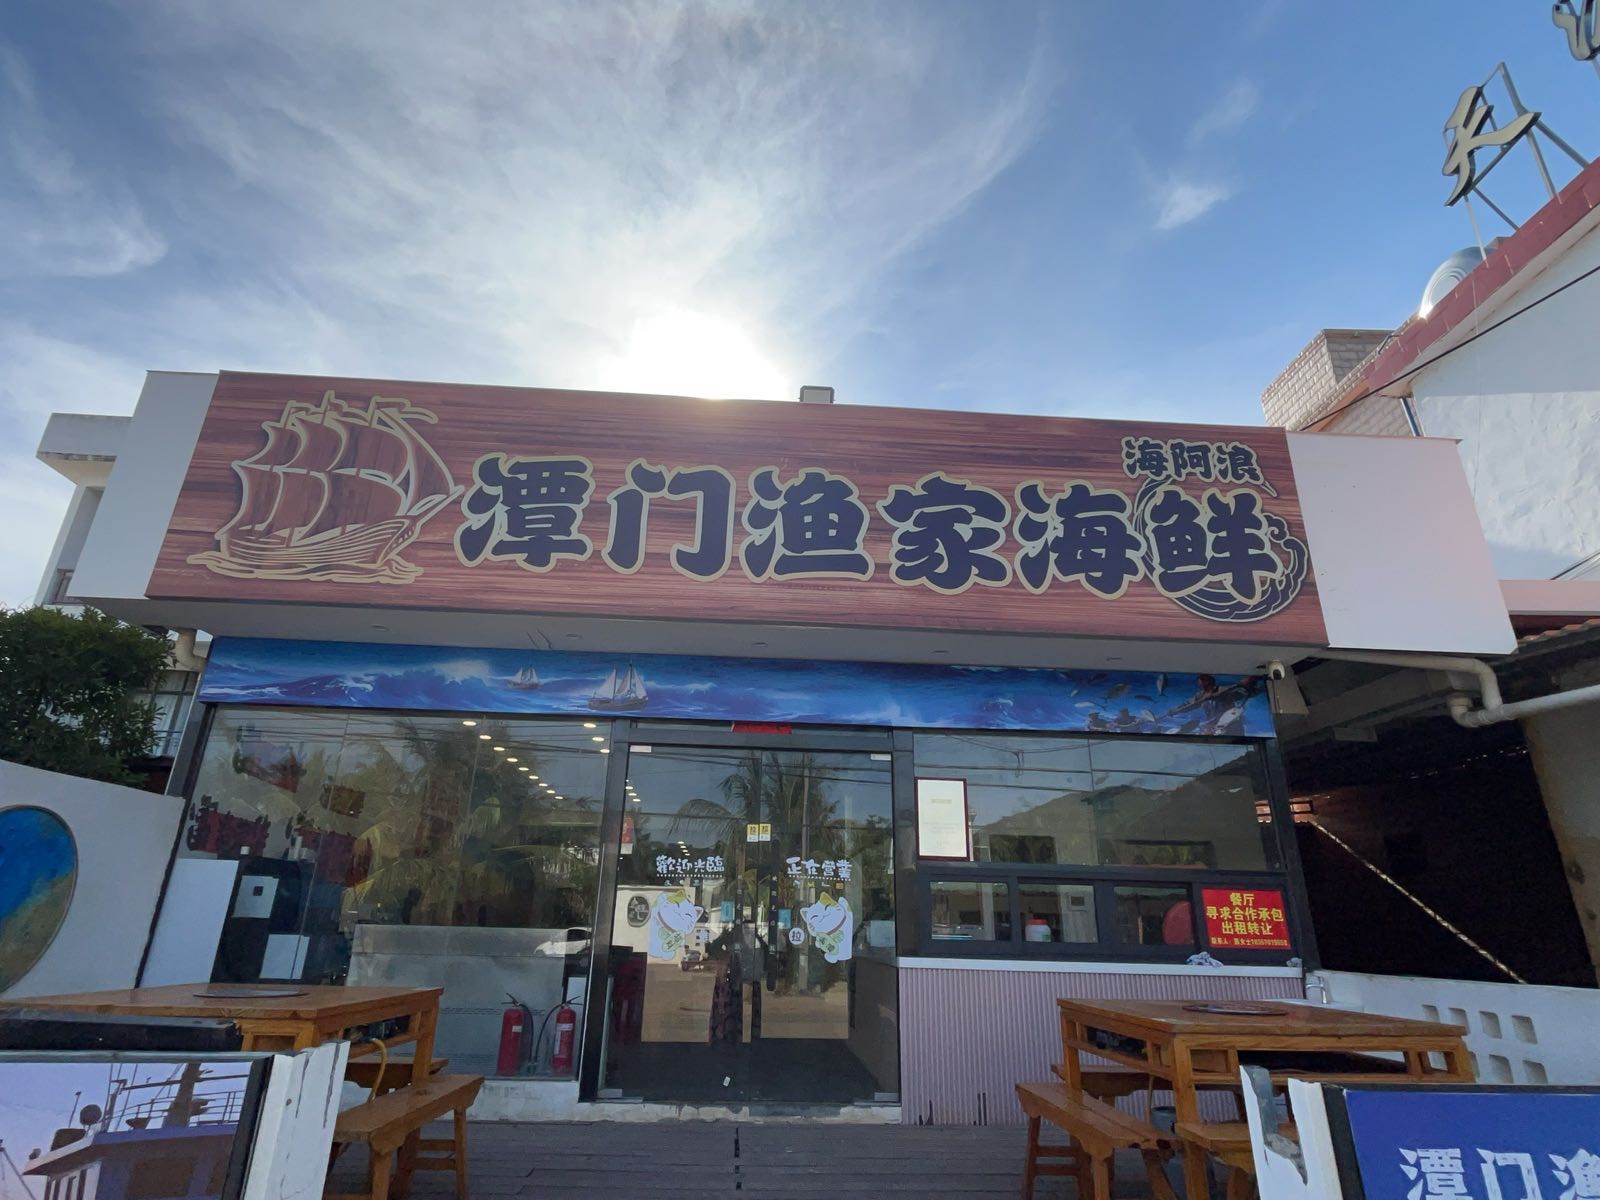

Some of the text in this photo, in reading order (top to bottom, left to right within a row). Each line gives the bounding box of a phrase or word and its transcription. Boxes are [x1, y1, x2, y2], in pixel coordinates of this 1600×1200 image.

[1121, 437, 1265, 484] 海阿浪
[454, 453, 1284, 604] 潭门渔家海鲜
[1229, 892, 1255, 906] 餐厅
[1206, 906, 1284, 921] 寻求合作承包
[1222, 921, 1273, 935] 出租转让
[791, 930, 802, 942] 拉
